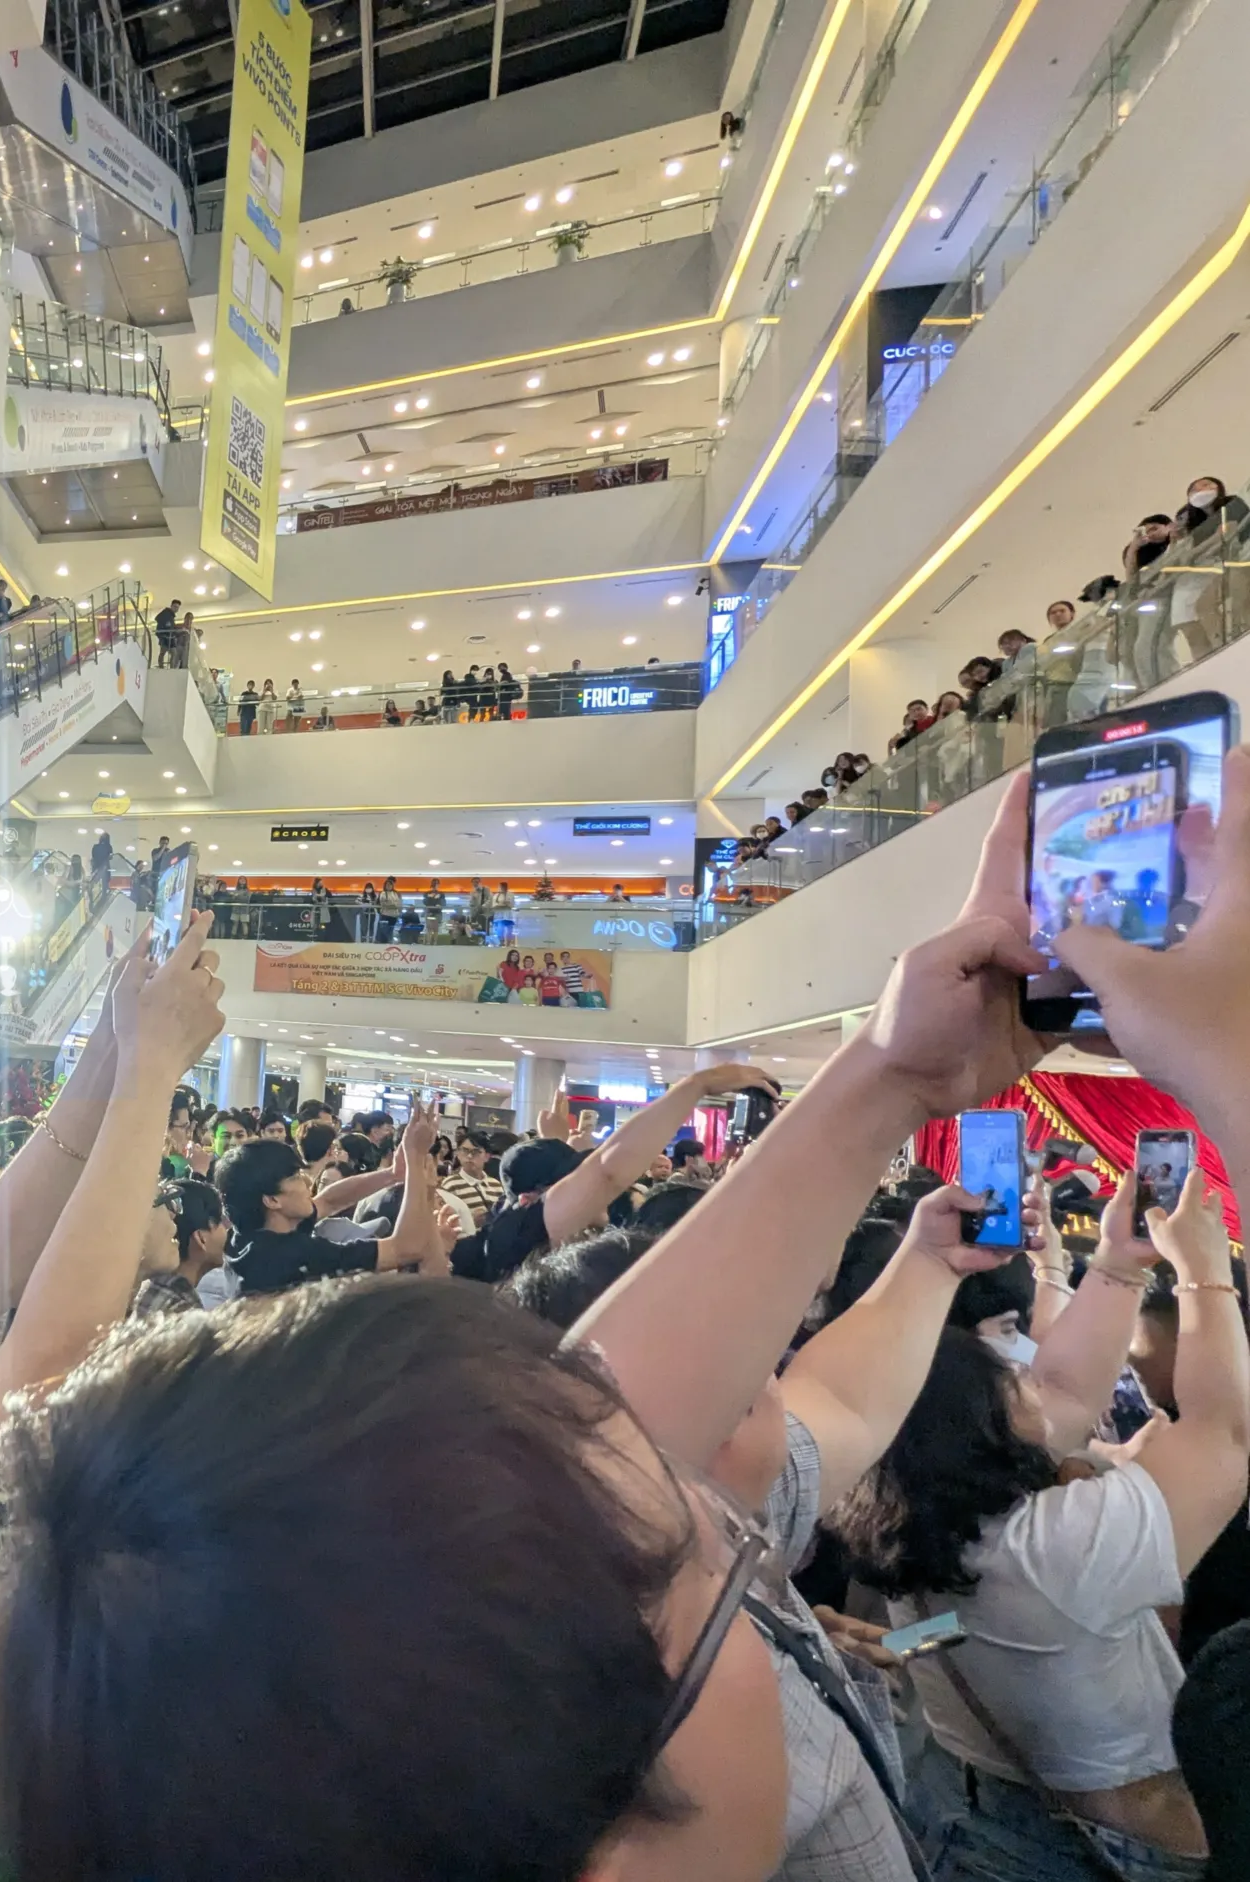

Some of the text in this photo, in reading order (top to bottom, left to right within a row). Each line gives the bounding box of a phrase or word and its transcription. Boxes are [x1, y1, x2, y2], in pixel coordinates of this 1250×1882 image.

[242, 52, 301, 147] VIVO POINTS
[226, 471, 241, 497] TẢI
[242, 487, 261, 512] APP
[582, 686, 630, 709] FRICO
[283, 829, 327, 838] CROSS
[321, 981, 328, 990] 2
[330, 981, 340, 991] &
[343, 982, 350, 991] 3
[350, 981, 385, 993] TTTM
[388, 983, 404, 994] SC
[404, 984, 458, 998] VivoCity
